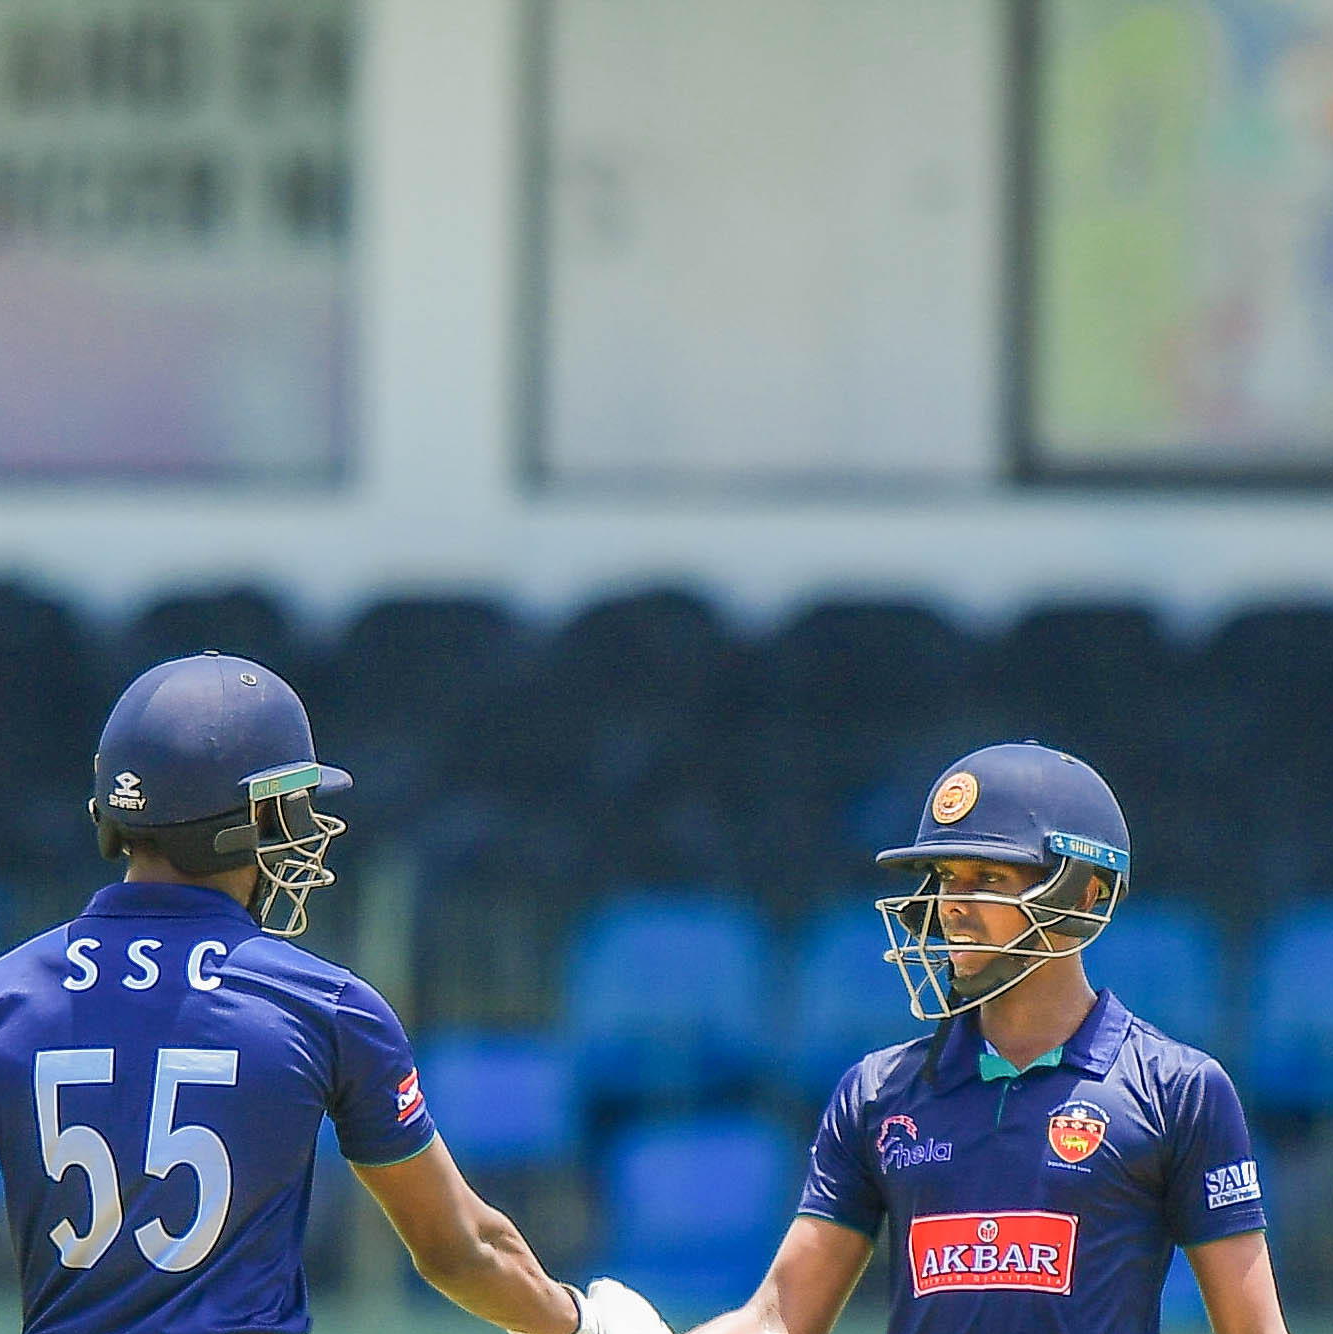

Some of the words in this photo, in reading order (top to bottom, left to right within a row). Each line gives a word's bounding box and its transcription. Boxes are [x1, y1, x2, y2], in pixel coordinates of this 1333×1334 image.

[108, 793, 147, 810] SHREY
[33, 1047, 240, 1273] 55
[921, 1243, 1060, 1278] AKBAR
